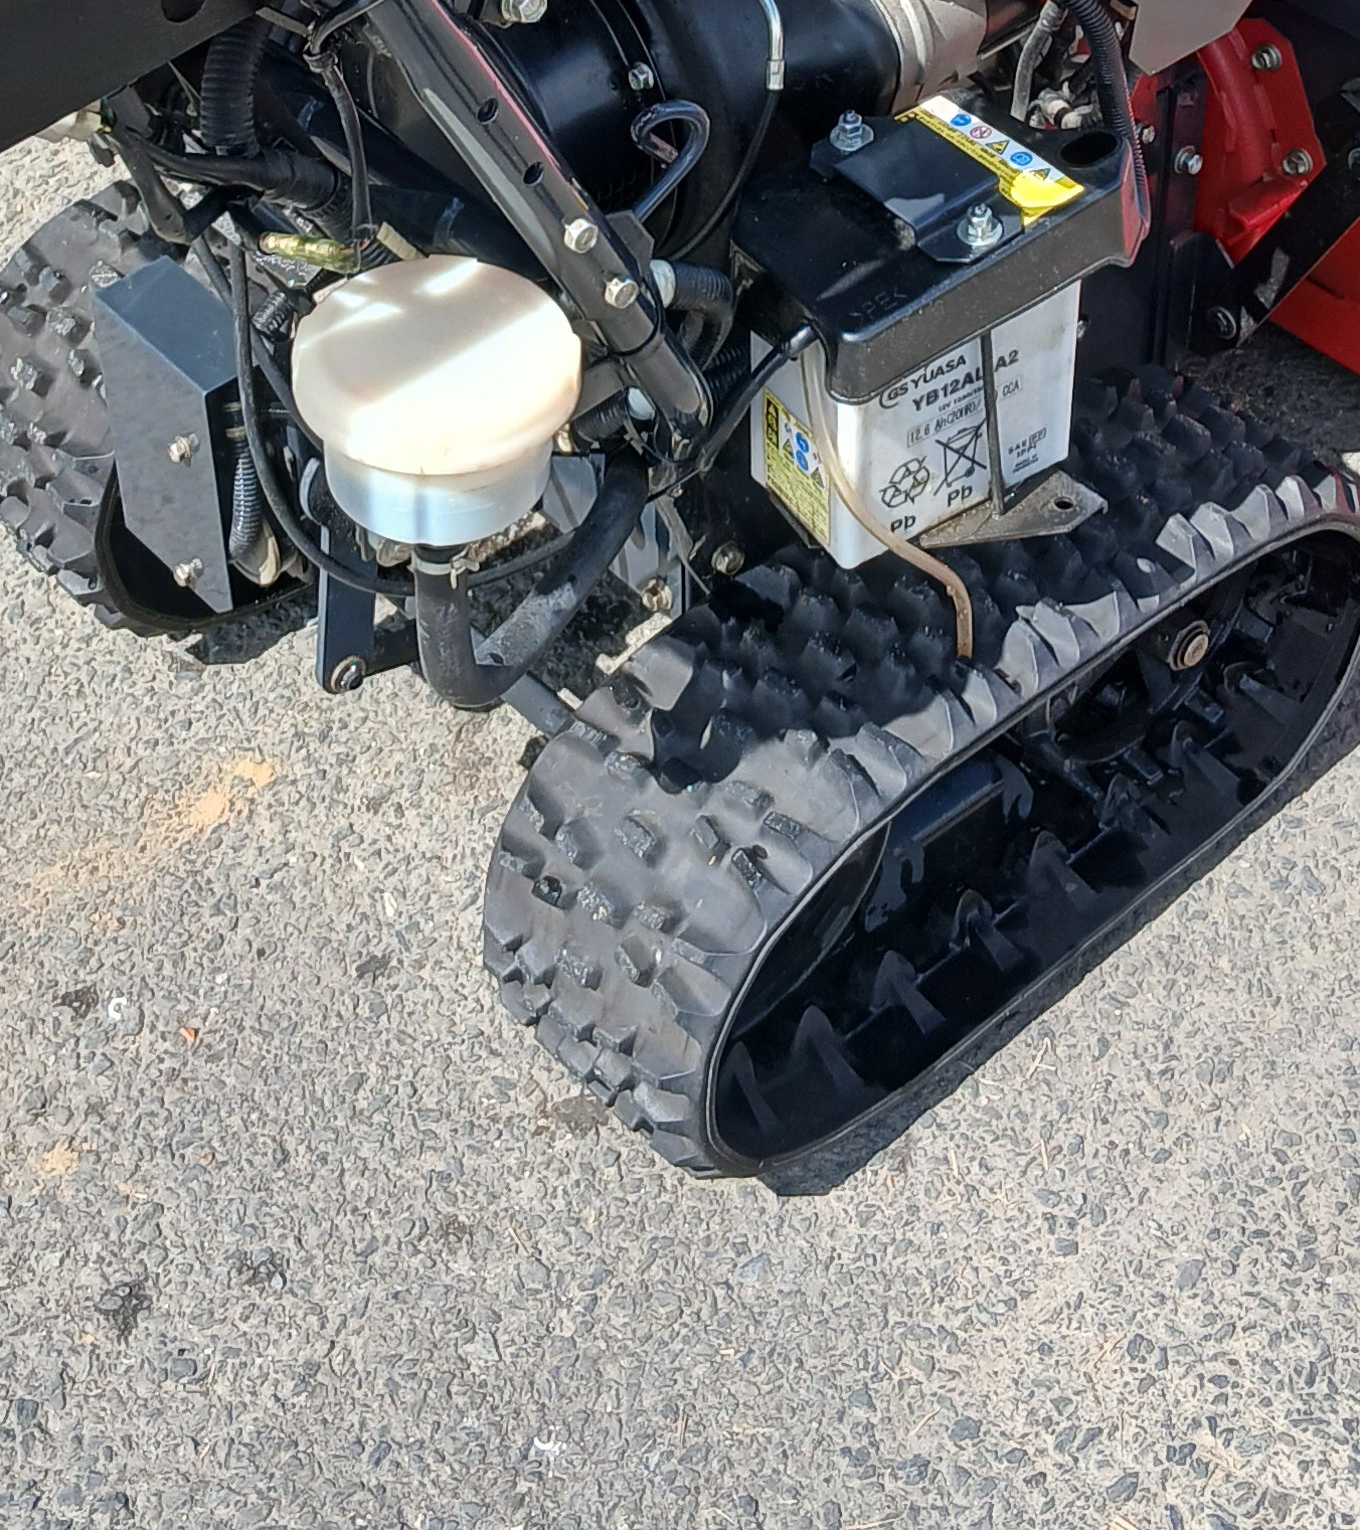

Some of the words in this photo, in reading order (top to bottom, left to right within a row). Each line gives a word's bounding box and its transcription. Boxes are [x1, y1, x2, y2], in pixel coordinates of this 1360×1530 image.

[910, 354, 968, 390] YUASA
[947, 484, 973, 508] Pb
[890, 515, 917, 534] Pb
